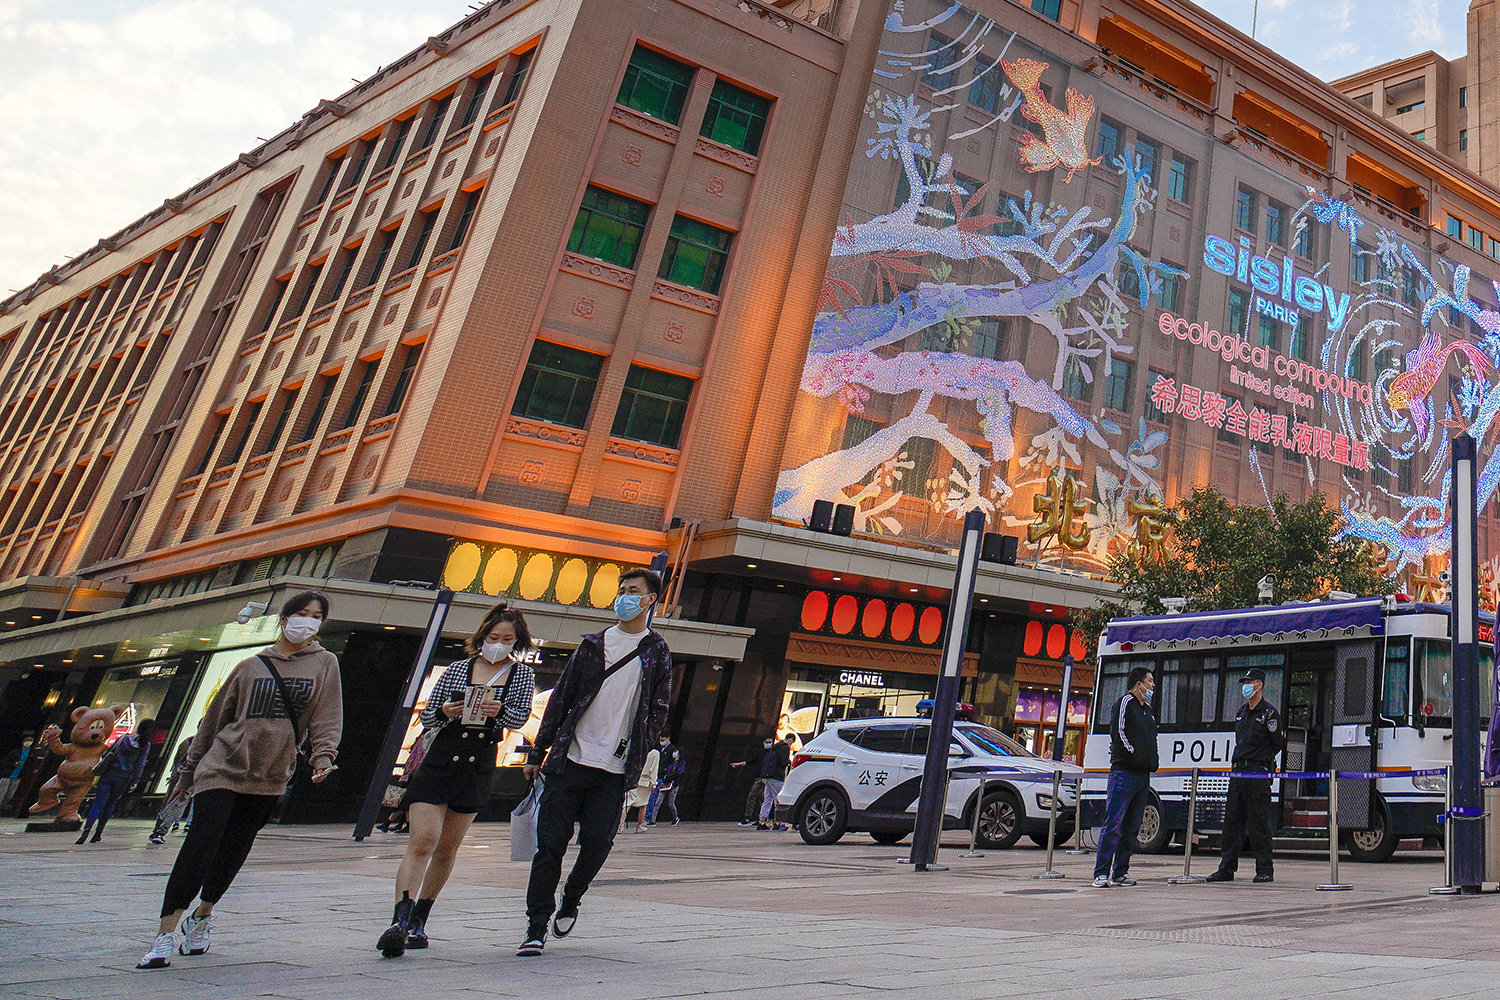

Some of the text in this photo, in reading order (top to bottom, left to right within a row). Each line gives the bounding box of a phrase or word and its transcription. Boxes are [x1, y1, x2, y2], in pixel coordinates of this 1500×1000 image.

[1203, 234, 1350, 332] sisley
[1256, 296, 1299, 326] PARIS
[1159, 312, 1372, 405] ecological compound
[1230, 365, 1315, 410] limited edition
[1150, 374, 1371, 472] 希思黎全能乳液限量版
[840, 672, 884, 686] CHANEL
[1172, 739, 1230, 763] POLI
[858, 770, 889, 786] 公安
